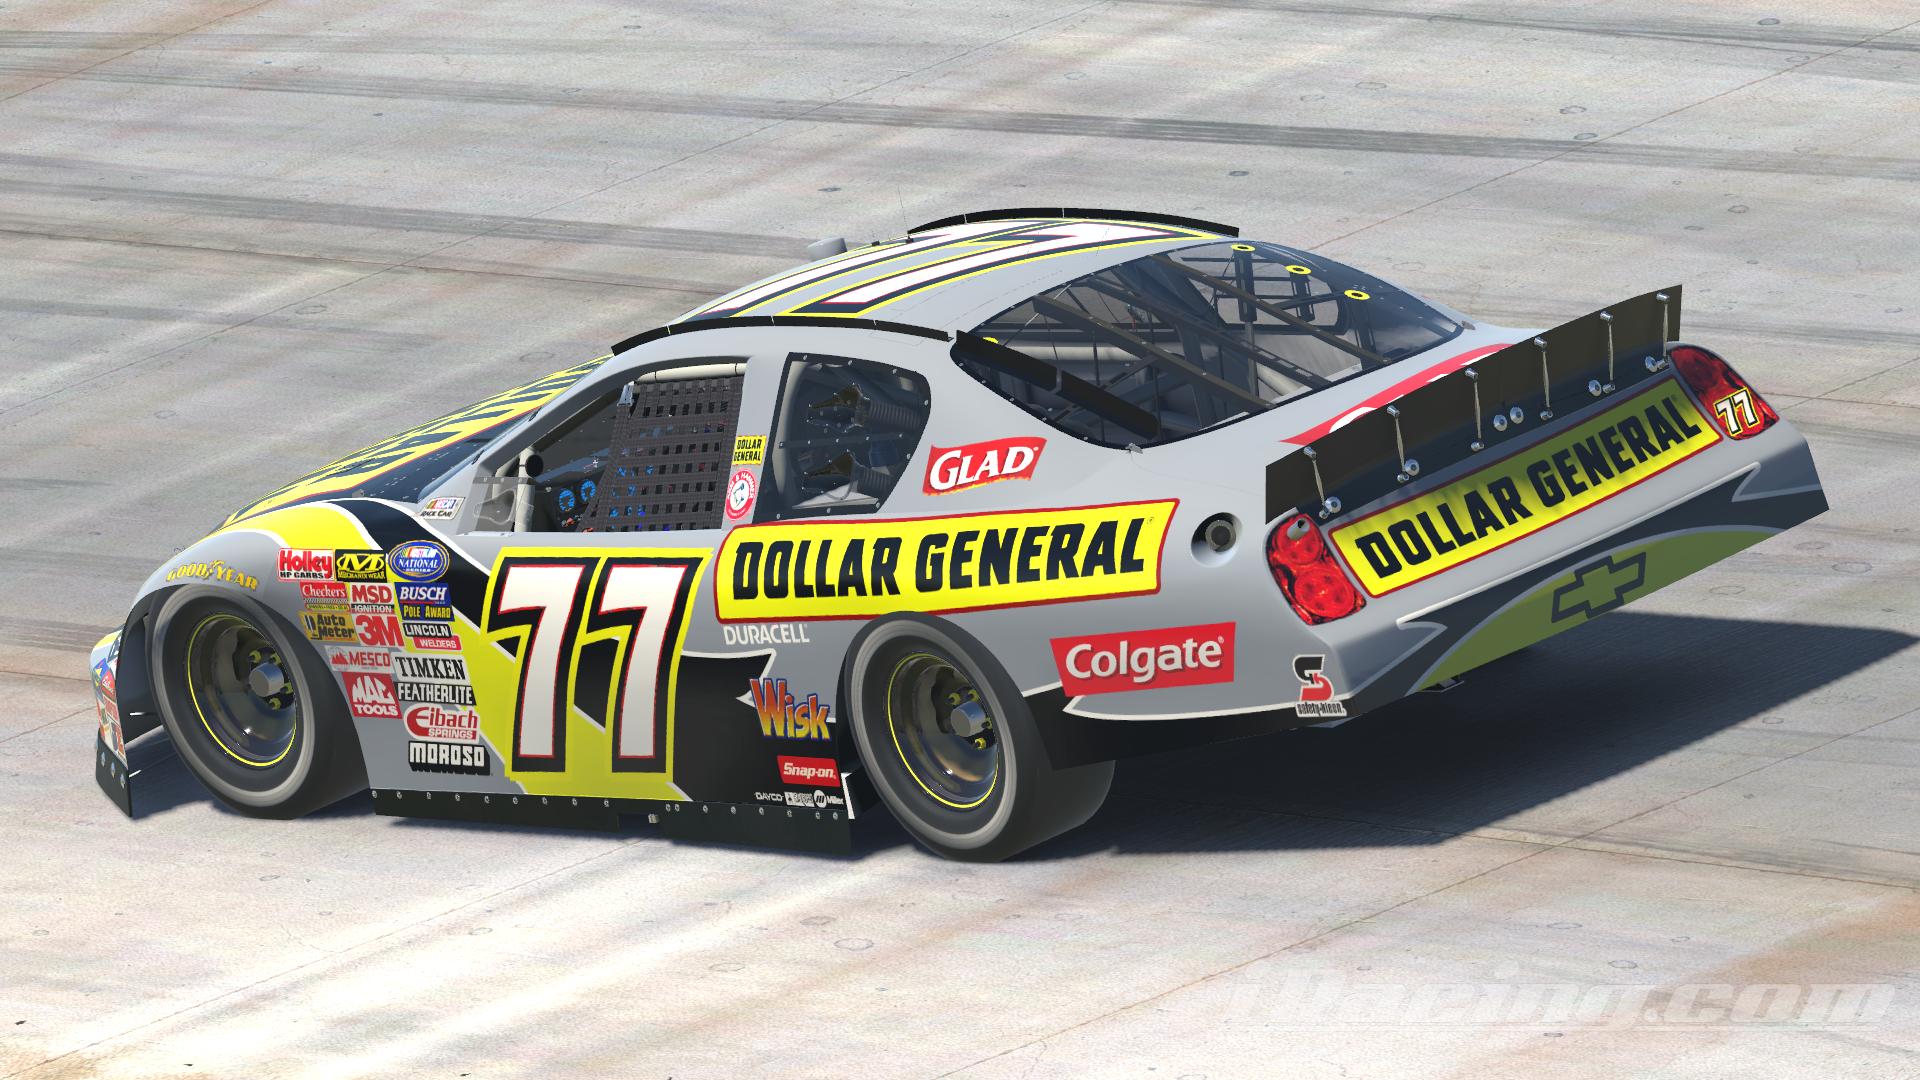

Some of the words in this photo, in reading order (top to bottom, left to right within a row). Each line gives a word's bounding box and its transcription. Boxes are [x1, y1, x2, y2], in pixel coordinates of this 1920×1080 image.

[1714, 388, 1759, 436] 77
[736, 439, 762, 450] DOLLAR
[734, 451, 761, 462] GENERAL
[930, 446, 1035, 491] GLAD
[1355, 474, 1534, 578] DOLLAR
[1526, 396, 1702, 509] GENERAL
[279, 550, 333, 579] Holley
[399, 558, 438, 569] NATIONAL
[732, 536, 903, 600] DOLLAR
[915, 517, 1145, 593] GENERAL
[302, 584, 346, 598] Checkers
[351, 585, 392, 604] MSD
[400, 586, 448, 601] BUSCH
[354, 605, 392, 613] IGNITION
[404, 605, 421, 618] POLE
[425, 605, 451, 618] AWARD
[317, 614, 346, 626] Auto
[318, 626, 354, 639] Meter
[355, 614, 404, 646] 3M
[404, 624, 450, 637] LINCOLN
[722, 624, 810, 645] DURACELL
[419, 638, 457, 649] WELDERS
[348, 651, 391, 667] MESCO
[395, 656, 466, 680] TIMKEN
[487, 557, 703, 772] 77
[1065, 637, 1223, 683] Colgate
[352, 675, 396, 705] MAC
[397, 682, 473, 704] FEATHERLITE
[355, 703, 399, 716] TOOLS
[750, 678, 831, 740] Wisk
[406, 706, 478, 737] Eibach
[428, 727, 474, 739] SPRINGS
[409, 742, 486, 769] MOROSO
[783, 762, 835, 779] Snap-on
[755, 791, 783, 802] DAYCO
